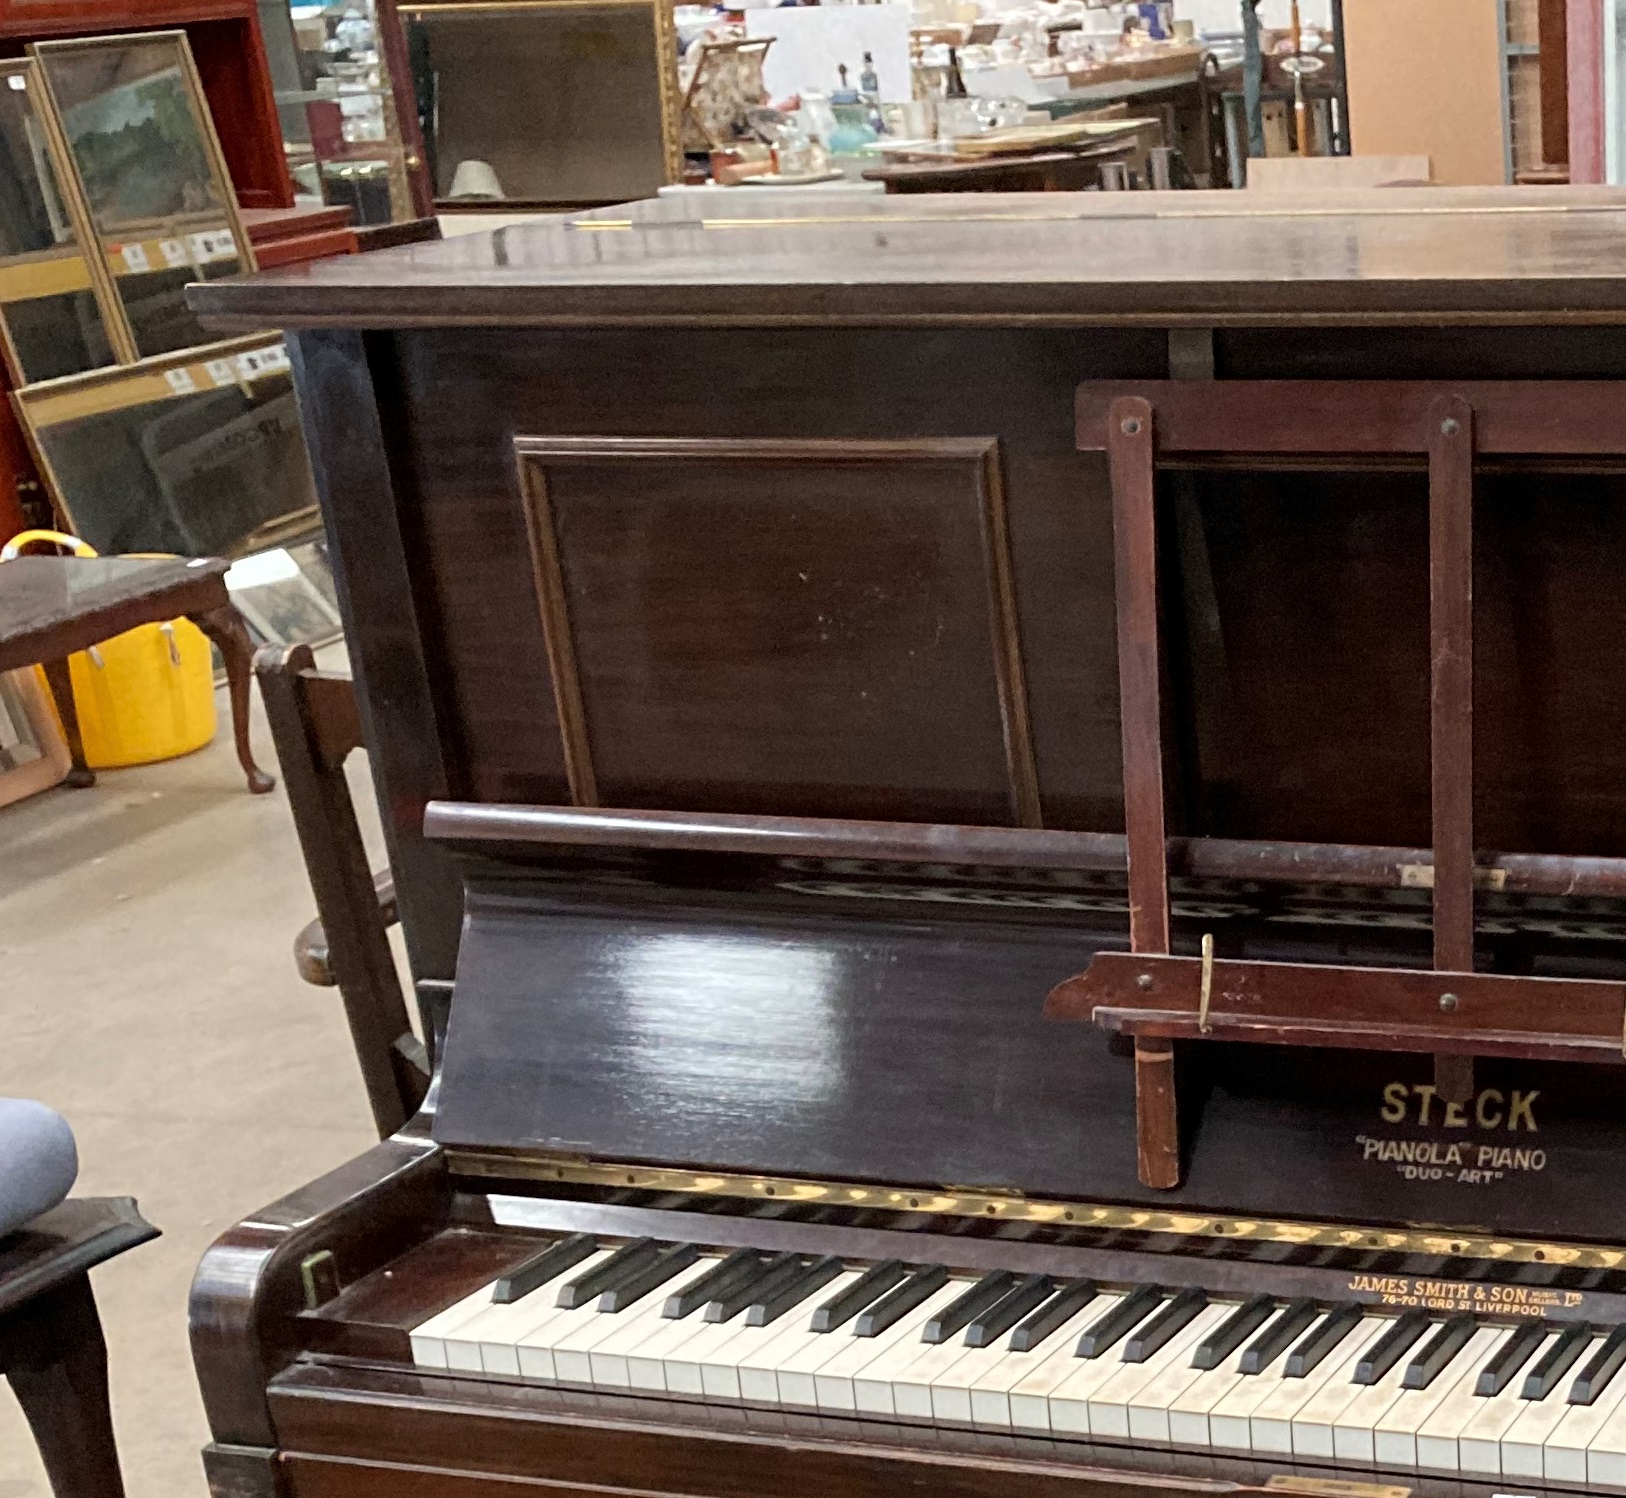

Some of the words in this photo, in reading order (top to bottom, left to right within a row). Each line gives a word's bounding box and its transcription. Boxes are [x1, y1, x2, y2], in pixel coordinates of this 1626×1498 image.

[1477, 1146, 1547, 1170] PIANO
[1348, 1275, 1408, 1294] JAMES
[1414, 1281, 1470, 1299] SMITH
[1473, 1286, 1486, 1301] &
[1490, 1286, 1529, 1304] SON
[1475, 1302, 1547, 1317] LIVERPOOL
